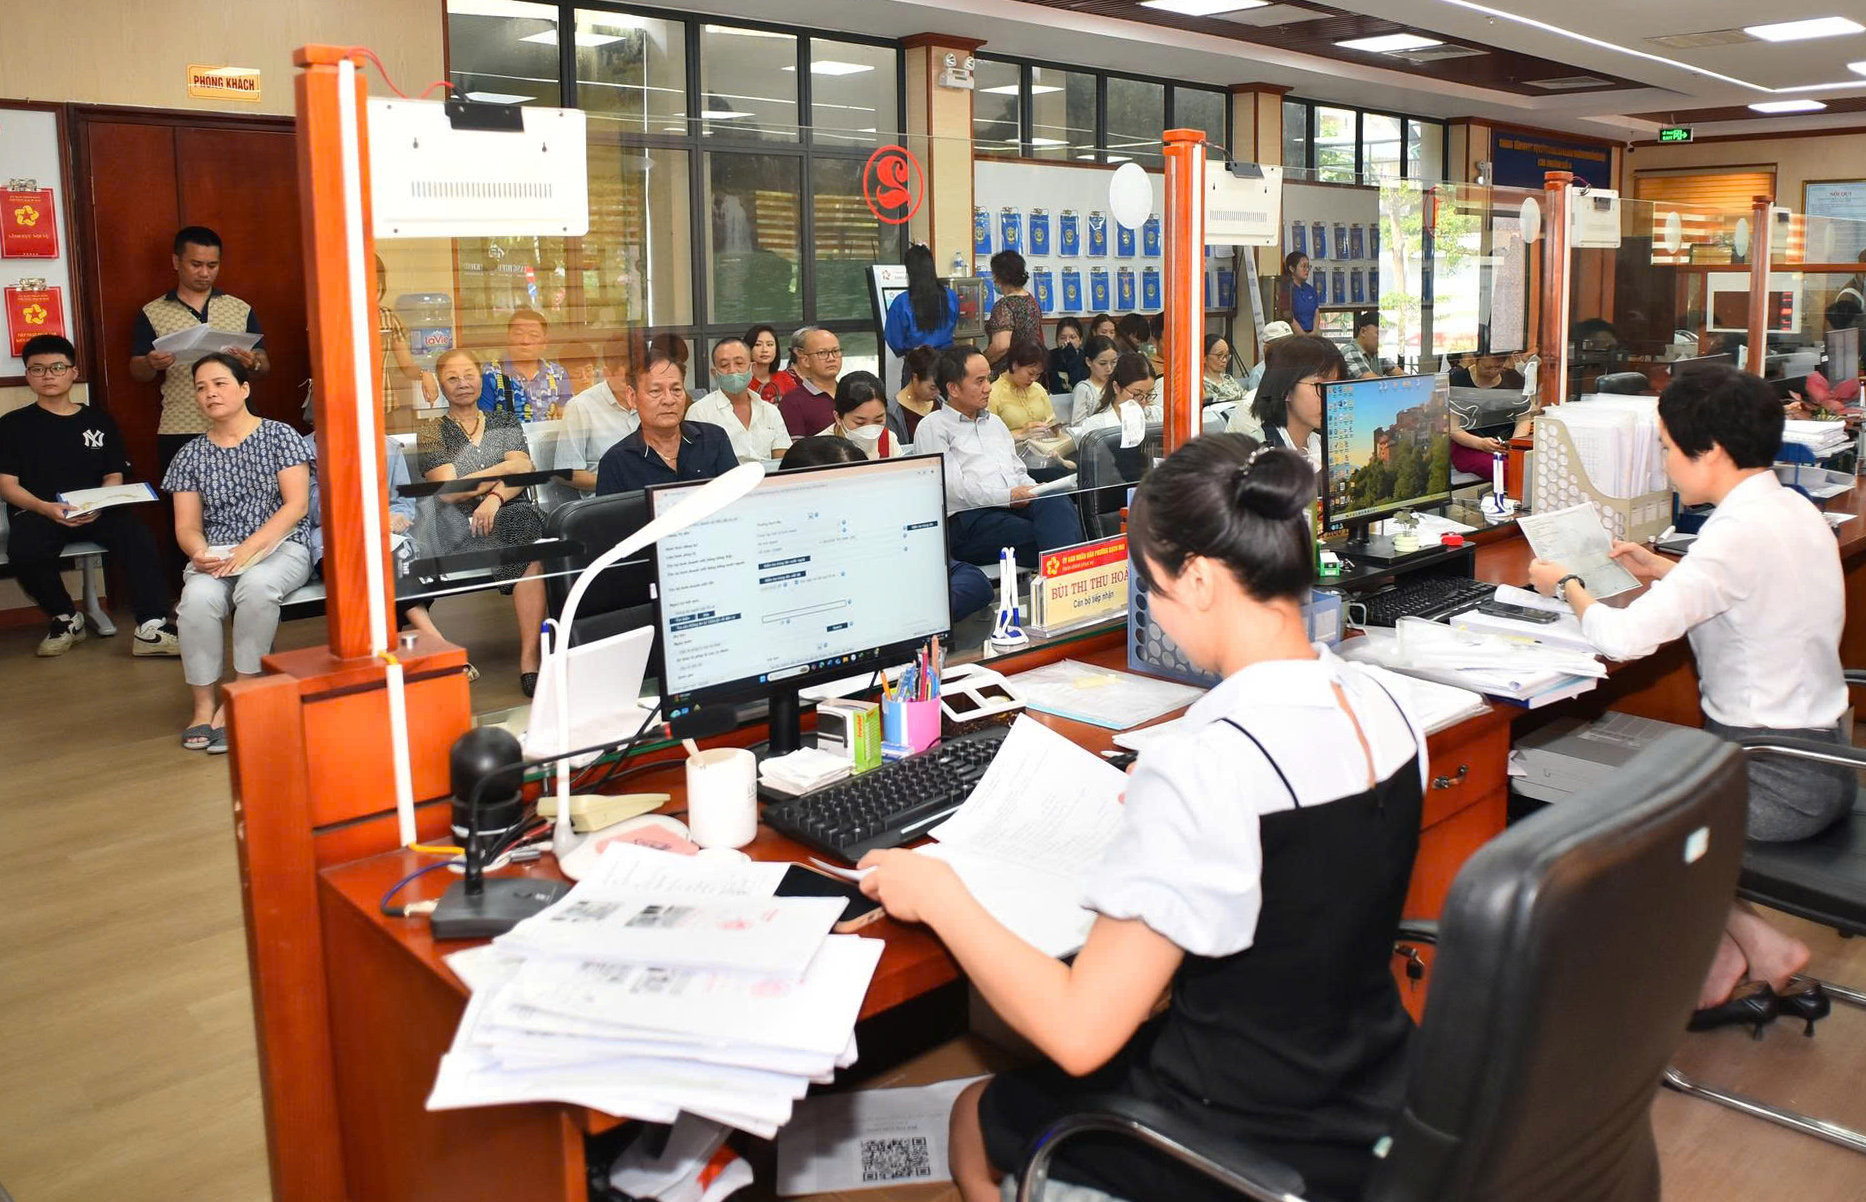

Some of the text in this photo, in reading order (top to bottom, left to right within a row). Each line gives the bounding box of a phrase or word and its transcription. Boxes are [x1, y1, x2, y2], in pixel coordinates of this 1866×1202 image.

[82, 429, 105, 447] NY
[1071, 580, 1087, 595] THỊ
[1090, 574, 1109, 590] THU
